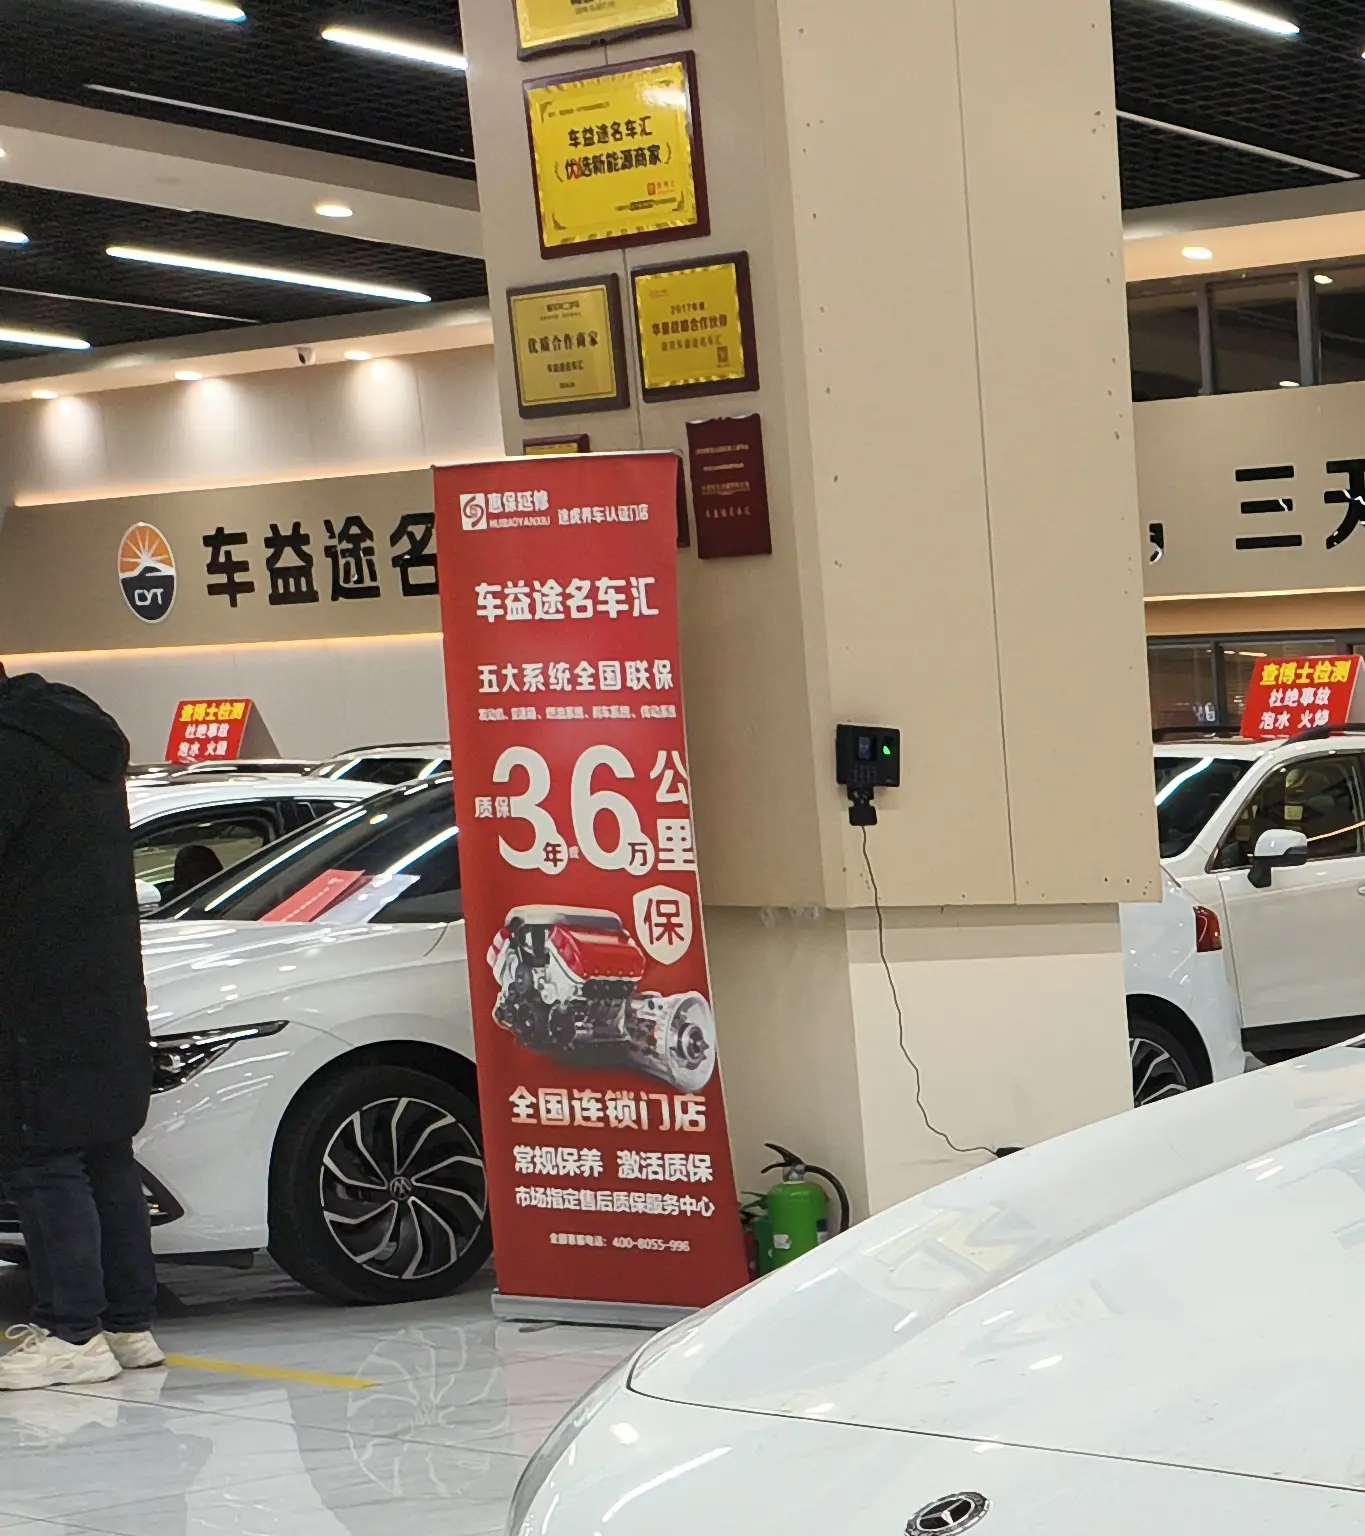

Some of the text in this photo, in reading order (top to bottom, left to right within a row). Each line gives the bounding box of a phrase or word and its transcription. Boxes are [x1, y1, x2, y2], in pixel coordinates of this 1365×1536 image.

[568, 116, 653, 148] 车益途名车汇
[475, 577, 659, 623] 车益途名车汇
[478, 659, 674, 693] 五大系统全国联保
[1259, 660, 1352, 686] 查博士检测
[1269, 686, 1332, 707] 杜绝事故
[643, 898, 685, 946] 保
[508, 1085, 707, 1133] 全国连锁门店
[513, 1145, 713, 1183] 常规保养 激活质保
[514, 1185, 715, 1217] 市场指定售后质保服务中心
